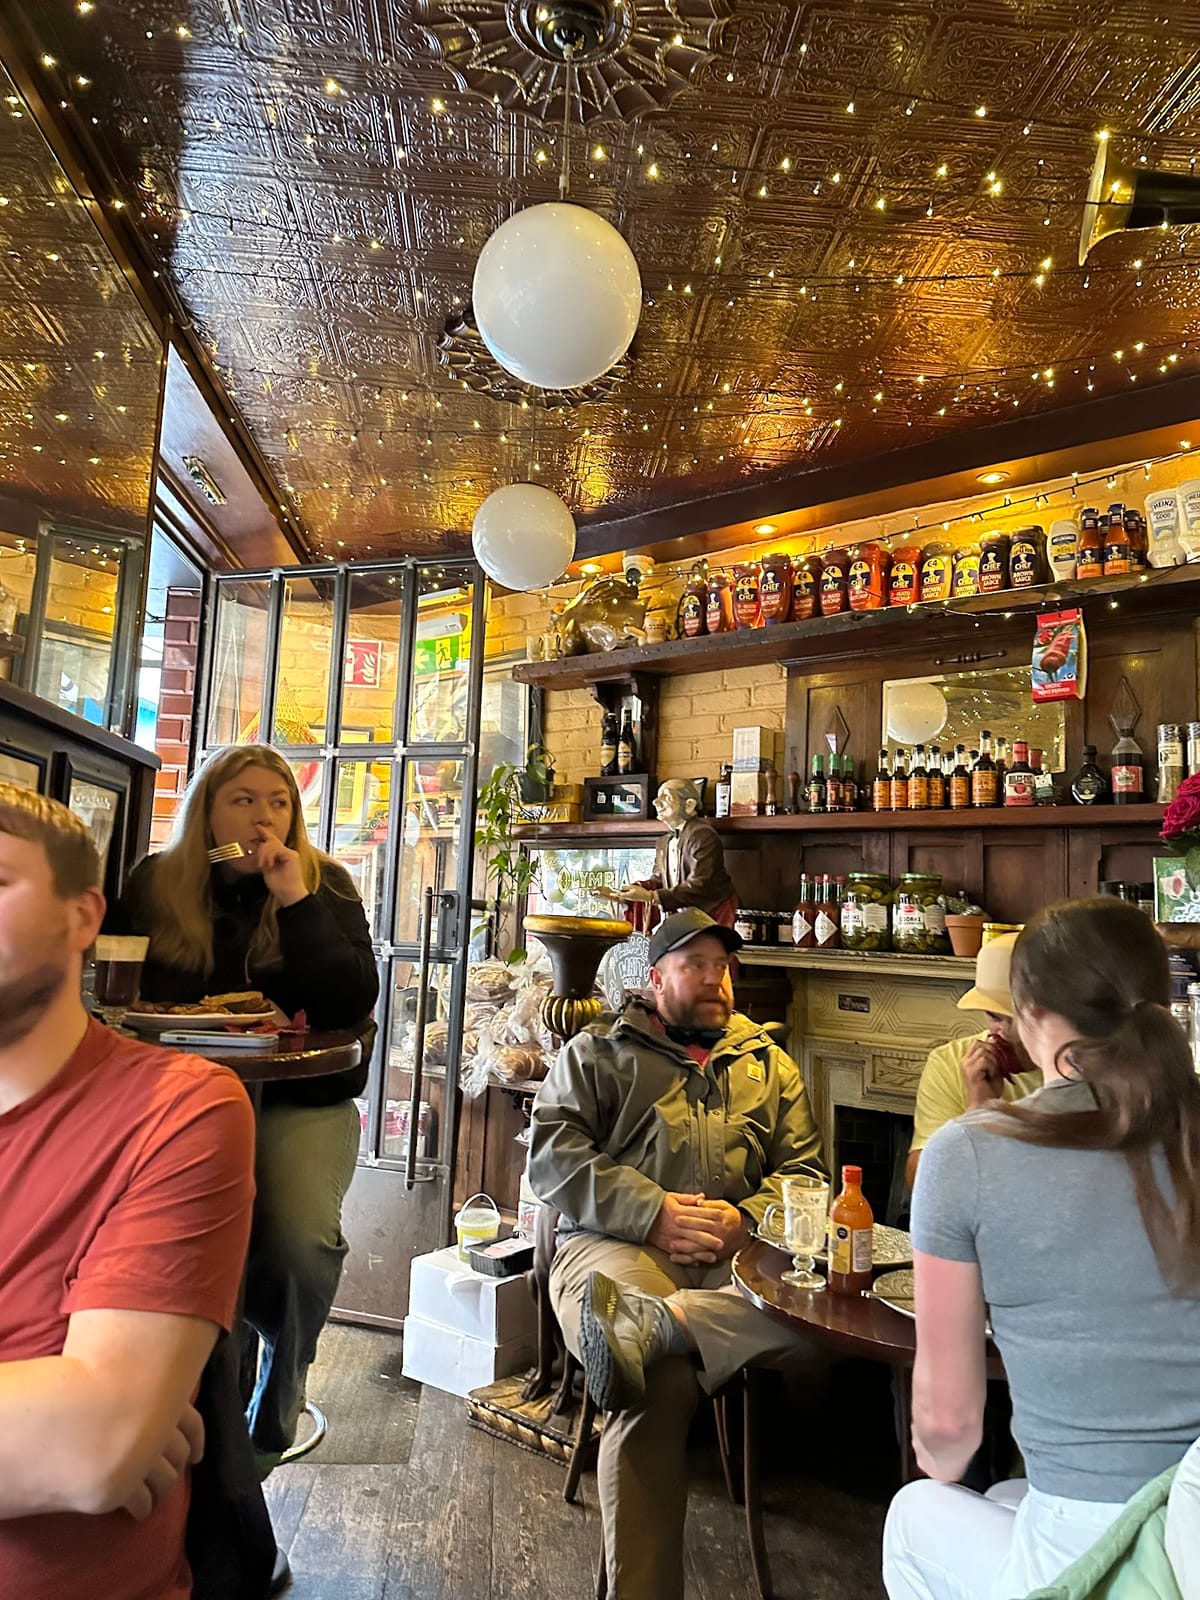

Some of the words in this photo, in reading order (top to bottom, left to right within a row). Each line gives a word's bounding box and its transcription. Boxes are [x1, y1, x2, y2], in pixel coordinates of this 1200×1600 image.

[1153, 500, 1174, 510] HEINZ
[926, 559, 939, 567] €4
[982, 562, 1002, 571] CHEF
[892, 579, 910, 588] CHEF
[923, 576, 941, 584] CHEF
[957, 576, 975, 585] CHEF
[761, 582, 780, 592] CHEF
[823, 582, 840, 591] CHEF
[921, 586, 942, 594] BROWN
[738, 593, 755, 601] CHEF
[558, 865, 631, 894] OLYMPIA
[613, 936, 650, 963] PLEASE
[619, 956, 645, 980] WAIT
